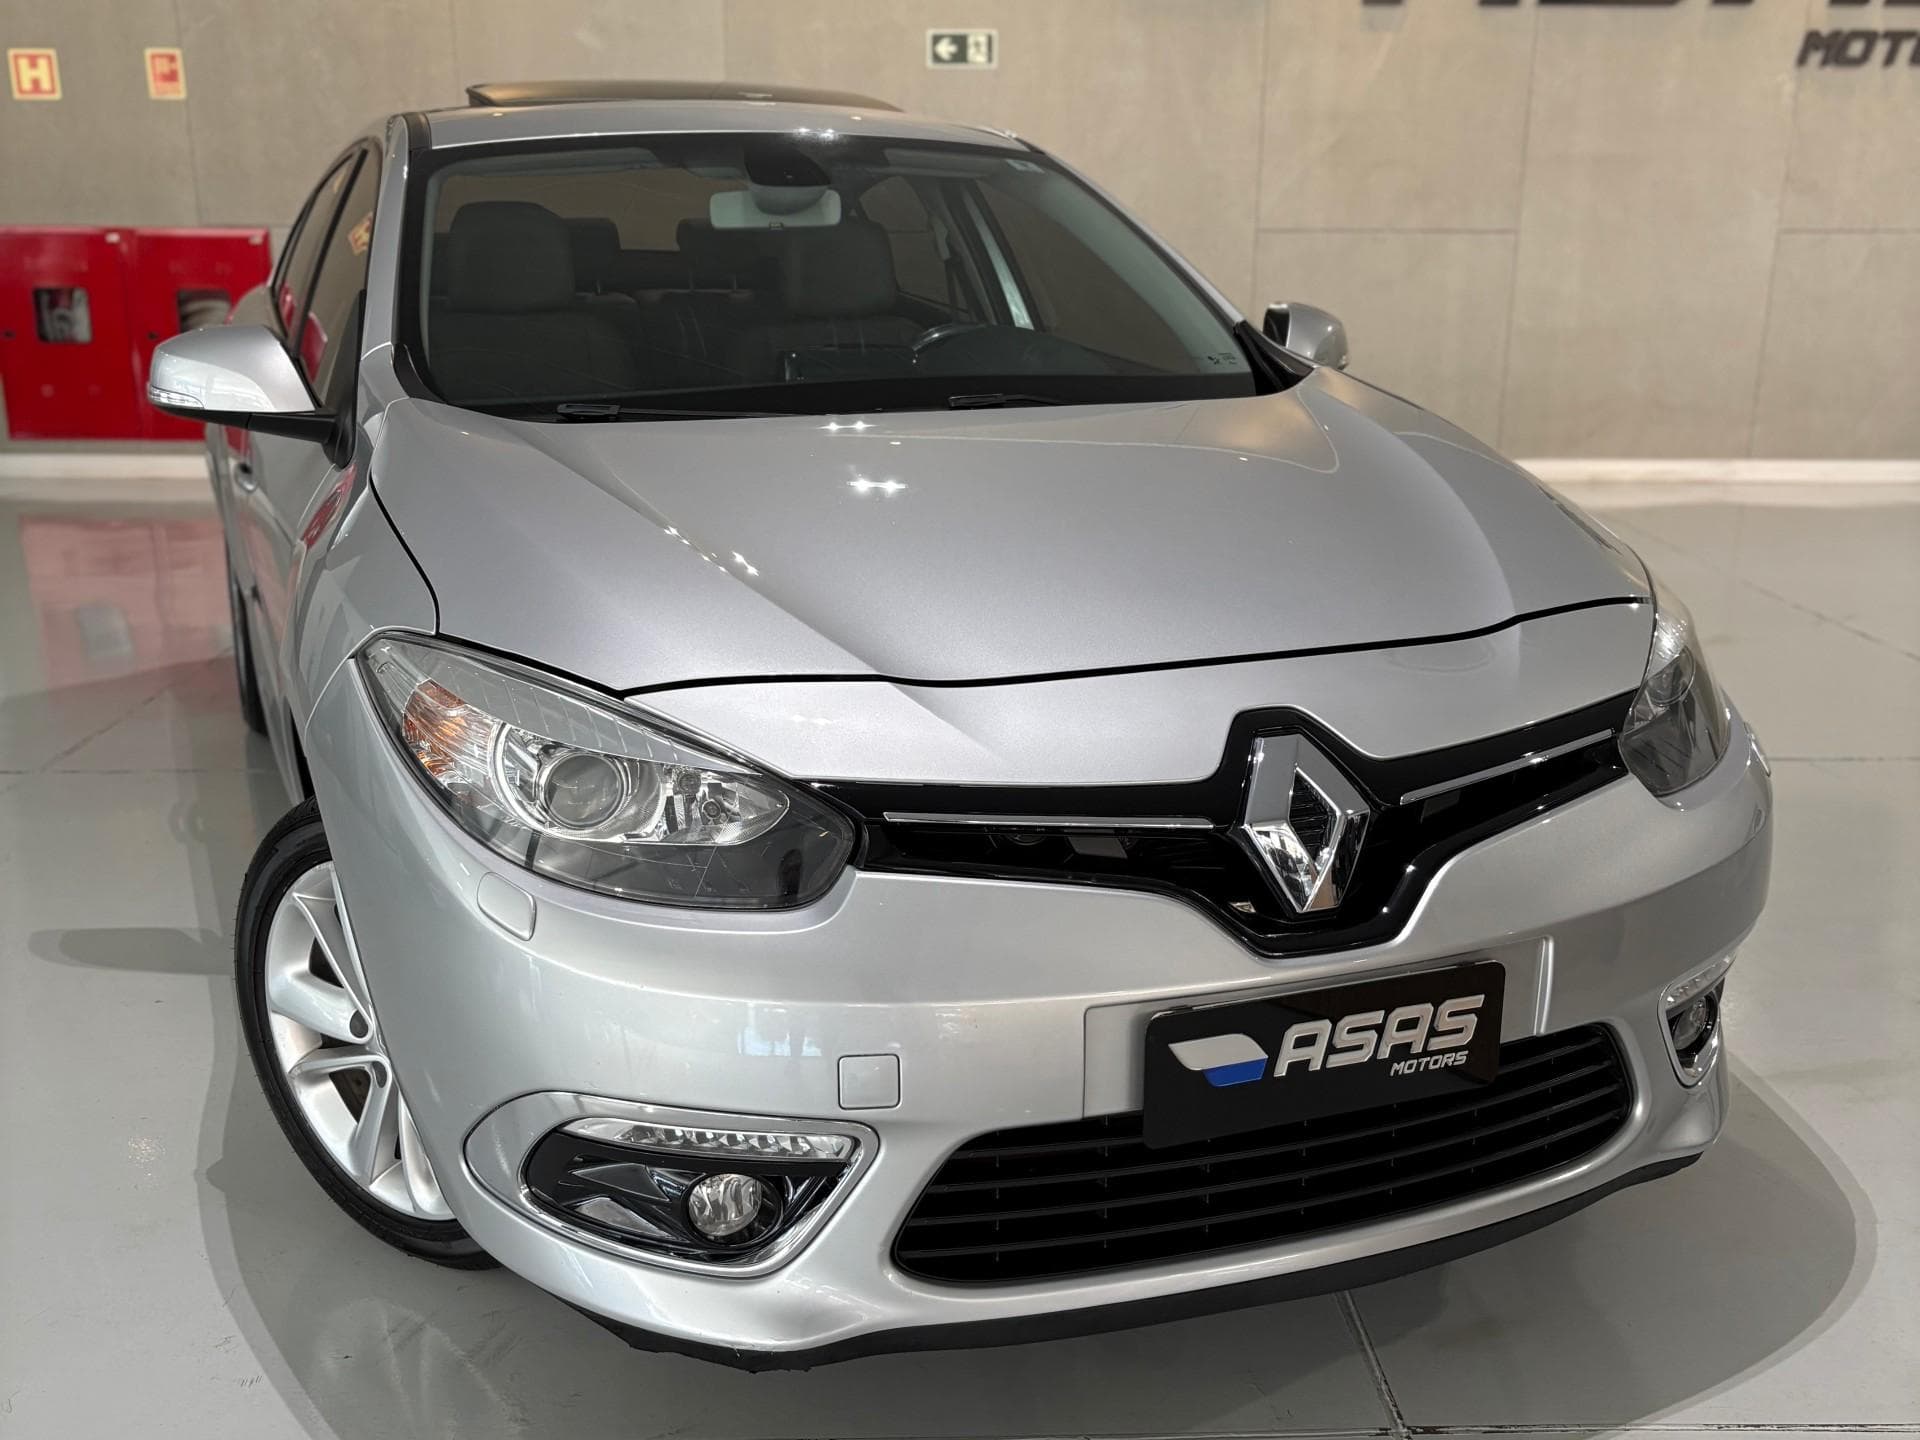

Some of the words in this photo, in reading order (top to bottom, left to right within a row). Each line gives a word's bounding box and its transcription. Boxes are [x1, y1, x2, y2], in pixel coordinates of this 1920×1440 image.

[17, 56, 53, 92] H
[1273, 994, 1485, 1077] ASAS
[1390, 1050, 1469, 1077] MOTORS
